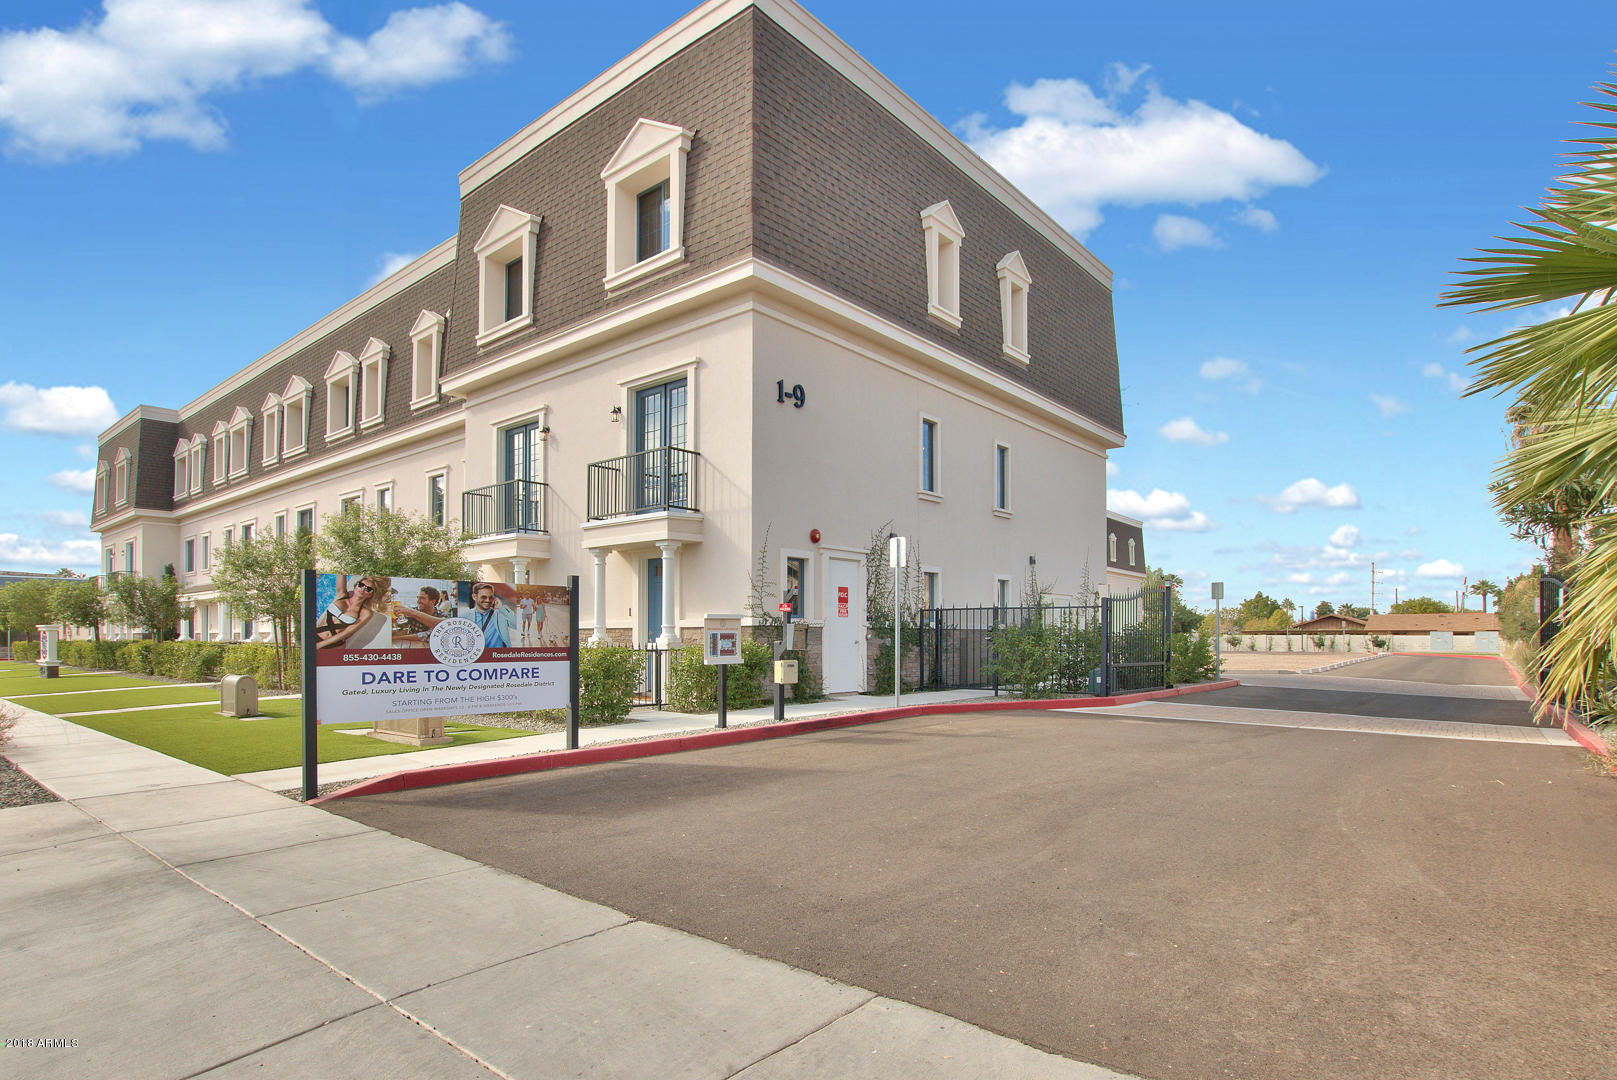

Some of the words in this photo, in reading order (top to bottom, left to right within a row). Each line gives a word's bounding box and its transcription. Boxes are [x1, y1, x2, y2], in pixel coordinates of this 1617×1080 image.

[777, 379, 806, 409] 1-9
[446, 620, 482, 638] ROSEDALE
[342, 653, 402, 662] 855-430-4438
[434, 648, 482, 664] RESIDENCES
[361, 670, 417, 685] DARE
[423, 669, 450, 683] TO
[456, 667, 540, 682] COMPARE
[371, 687, 397, 695] Luxury
[399, 686, 421, 694] Living
[445, 684, 467, 692] Newly
[468, 682, 505, 690] Designated
[505, 681, 533, 689] Rosedale
[392, 698, 433, 707] STARTING
[434, 697, 458, 705] FROM
